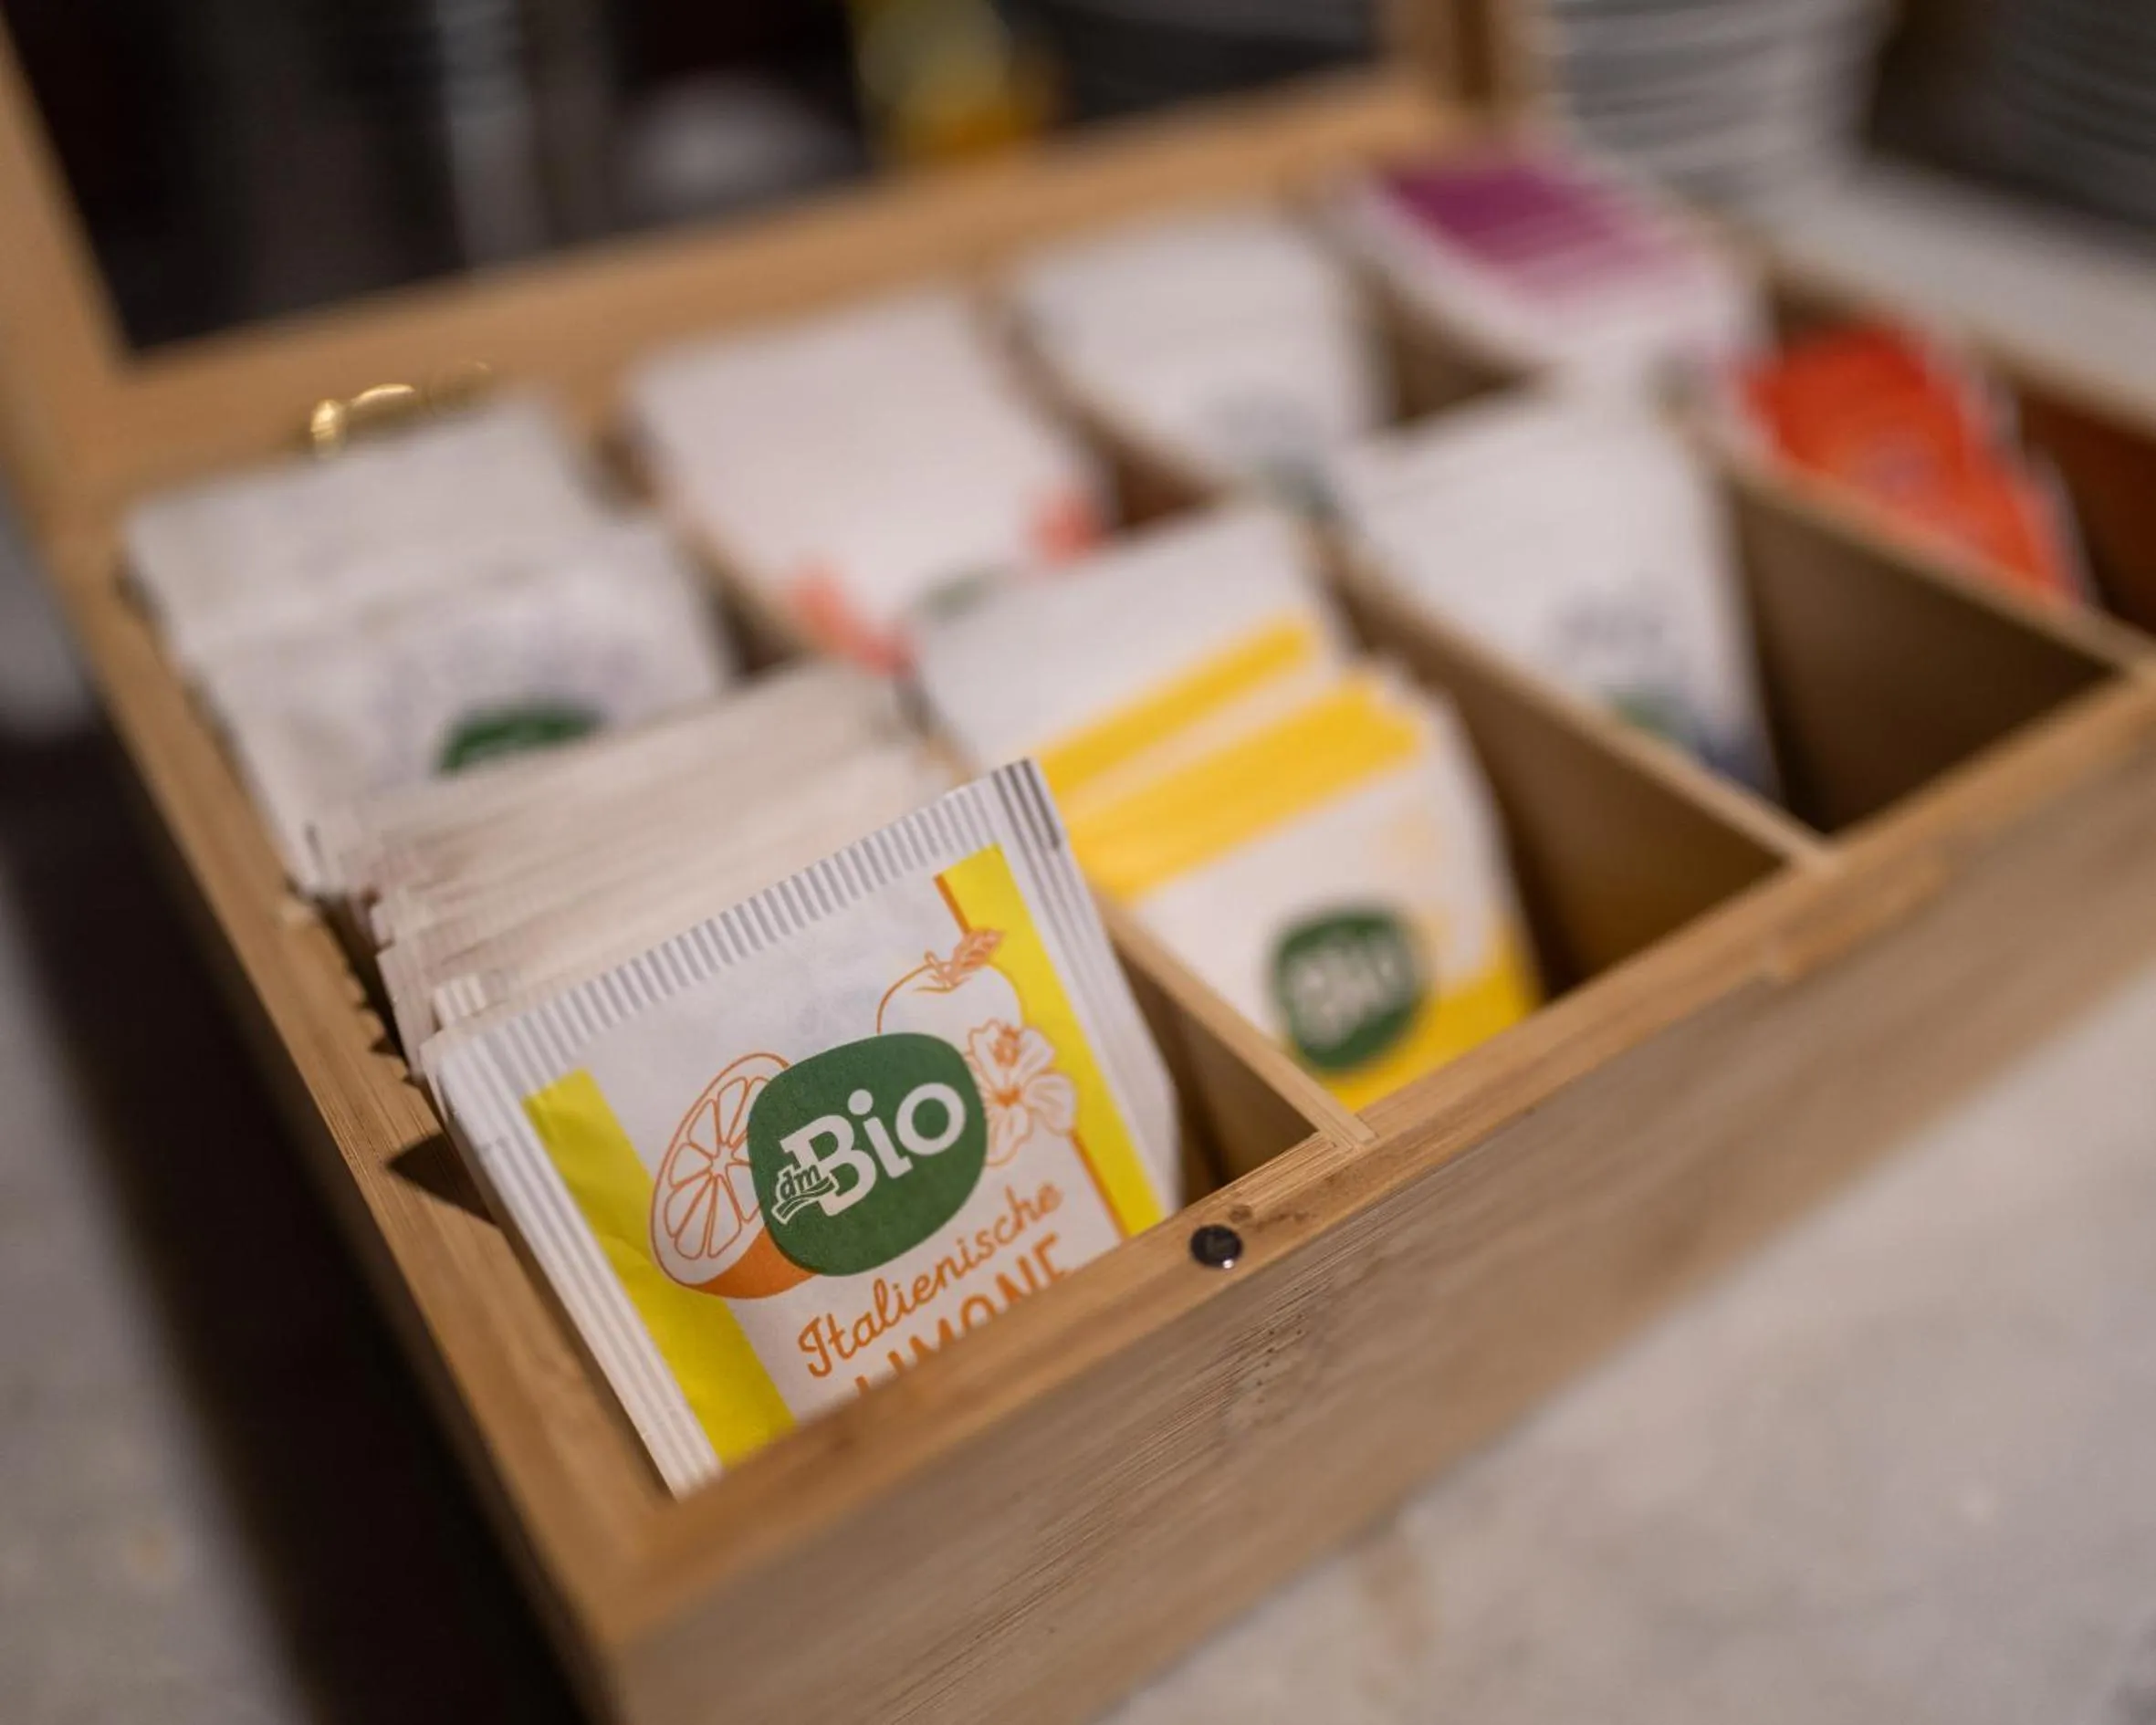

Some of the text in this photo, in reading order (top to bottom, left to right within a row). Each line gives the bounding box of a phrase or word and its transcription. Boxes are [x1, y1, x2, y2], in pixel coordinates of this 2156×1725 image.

[779, 1082, 967, 1218] Bio
[797, 1180, 1065, 1379] Italienische
[854, 1231, 1061, 1396] ONE
